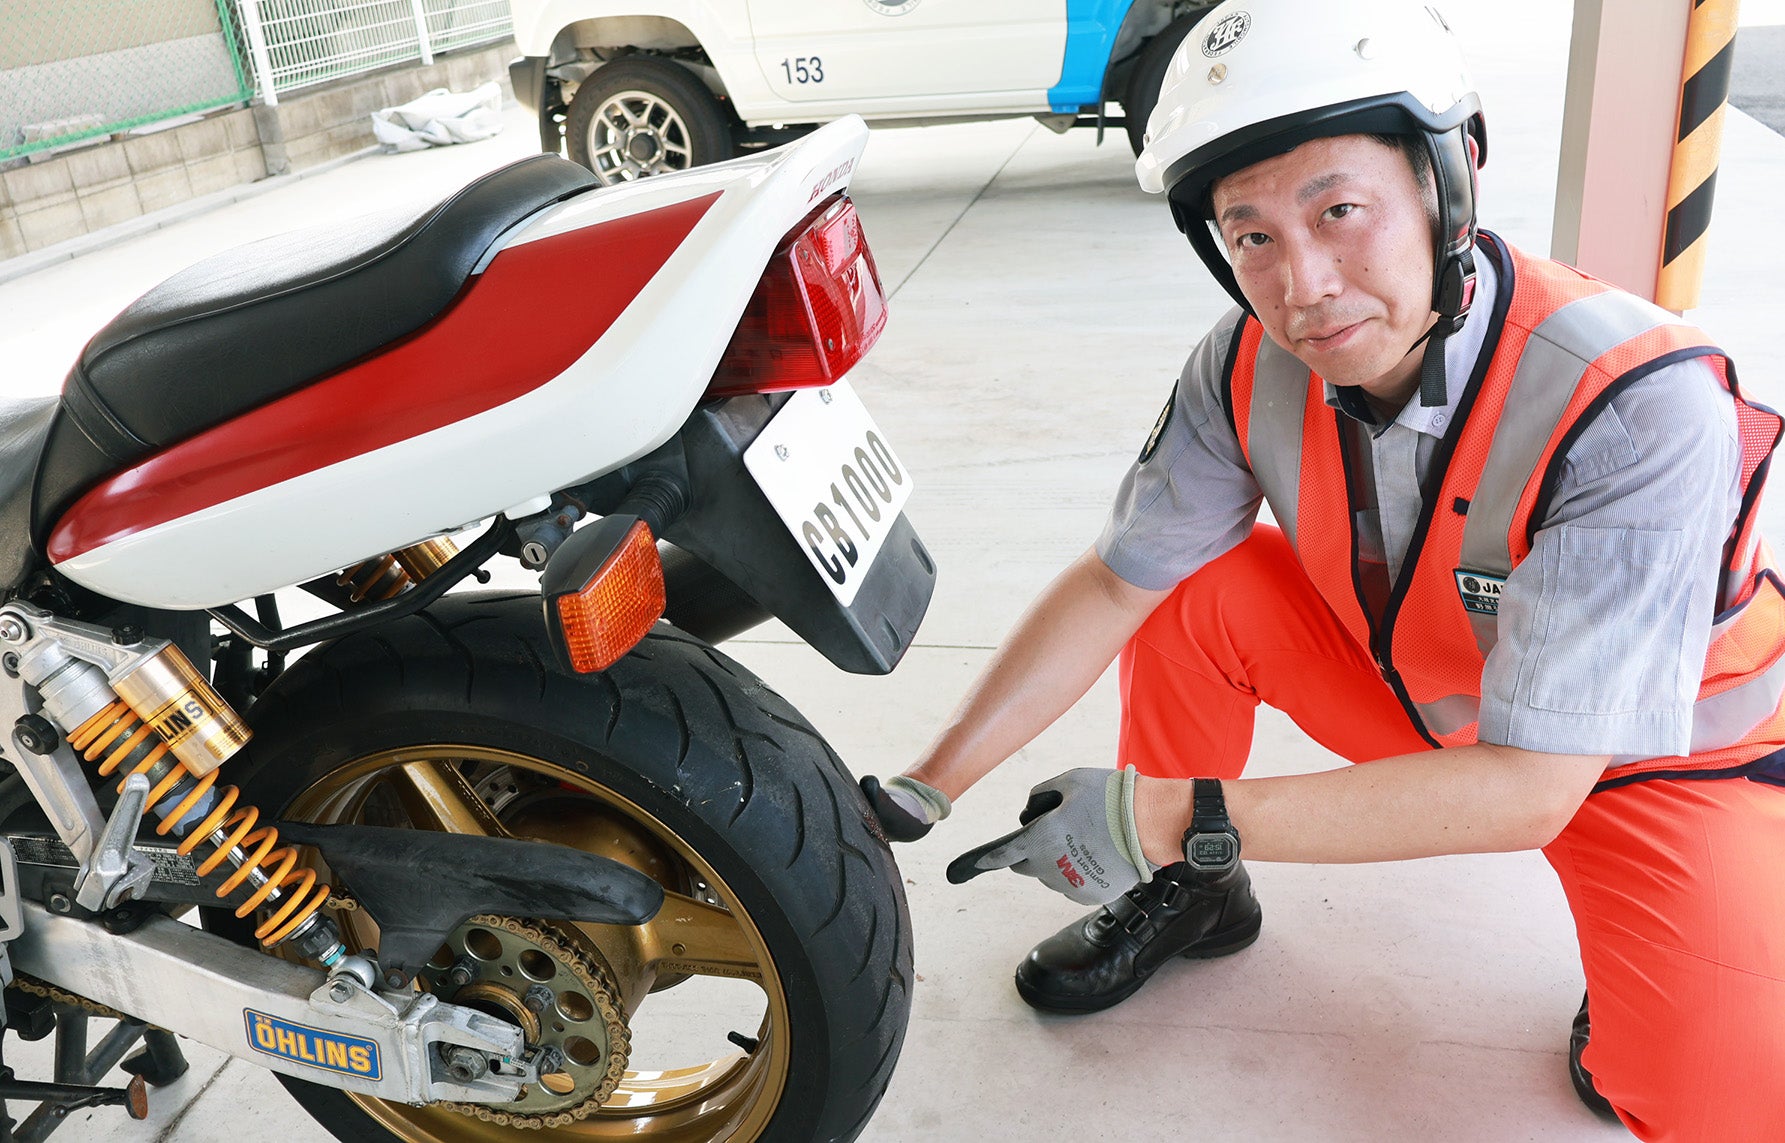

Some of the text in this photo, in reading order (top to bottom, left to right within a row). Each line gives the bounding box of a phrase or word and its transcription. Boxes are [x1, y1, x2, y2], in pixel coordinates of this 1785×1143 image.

[781, 56, 824, 84] 153
[808, 157, 855, 203] HONDA
[802, 430, 902, 585] CB1000
[1483, 582, 1504, 595] JA
[155, 700, 204, 740] LINS
[1056, 854, 1085, 888] 3M
[1065, 834, 1110, 889] Comfort Grip
[1080, 844, 1105, 875] Gloves
[255, 1015, 372, 1073] ÖHLINS
